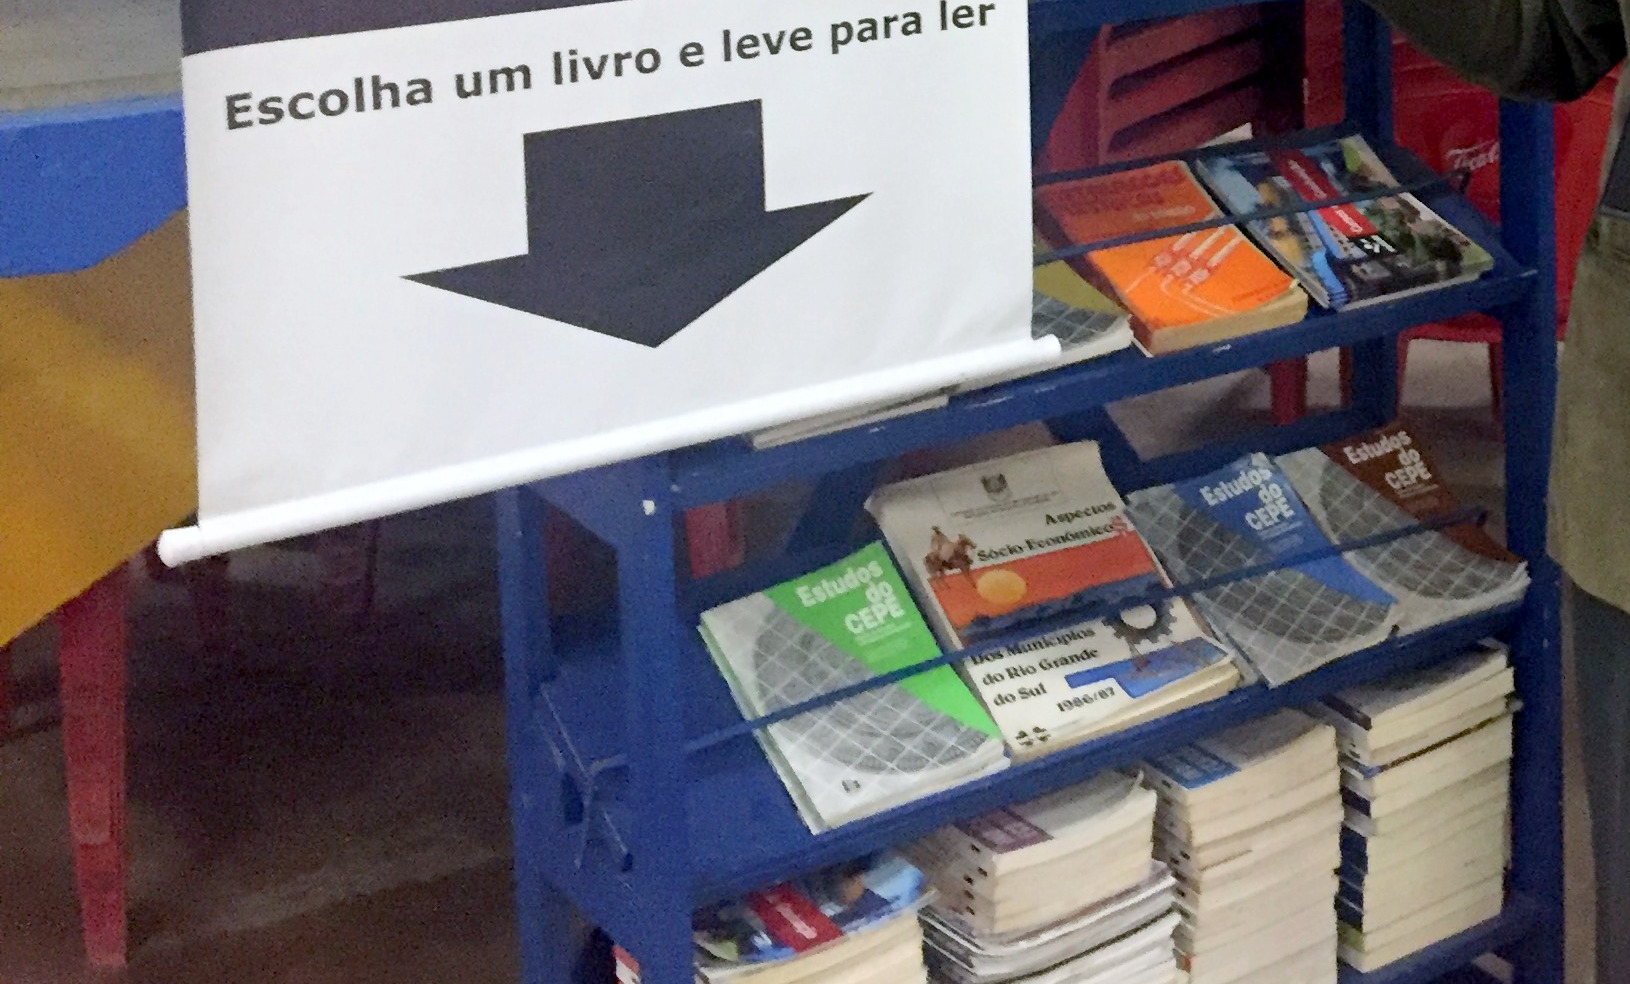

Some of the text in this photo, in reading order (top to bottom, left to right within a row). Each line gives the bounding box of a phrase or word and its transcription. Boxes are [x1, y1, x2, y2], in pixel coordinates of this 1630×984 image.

[225, 0, 996, 131] Escolha um livro e leve para ler
[1343, 430, 1412, 465] Estudos
[1398, 446, 1421, 466] do
[1199, 468, 1273, 507] Estudos
[1384, 460, 1432, 490] CEPE
[1258, 483, 1282, 504] do
[1045, 501, 1117, 526] Aspectos
[1244, 496, 1296, 531] CEPE
[795, 560, 884, 608] Estudos
[865, 580, 894, 604] do
[844, 595, 906, 635] CEPE
[982, 648, 1099, 687] do Rio Grande
[993, 681, 1048, 708] do Sul
